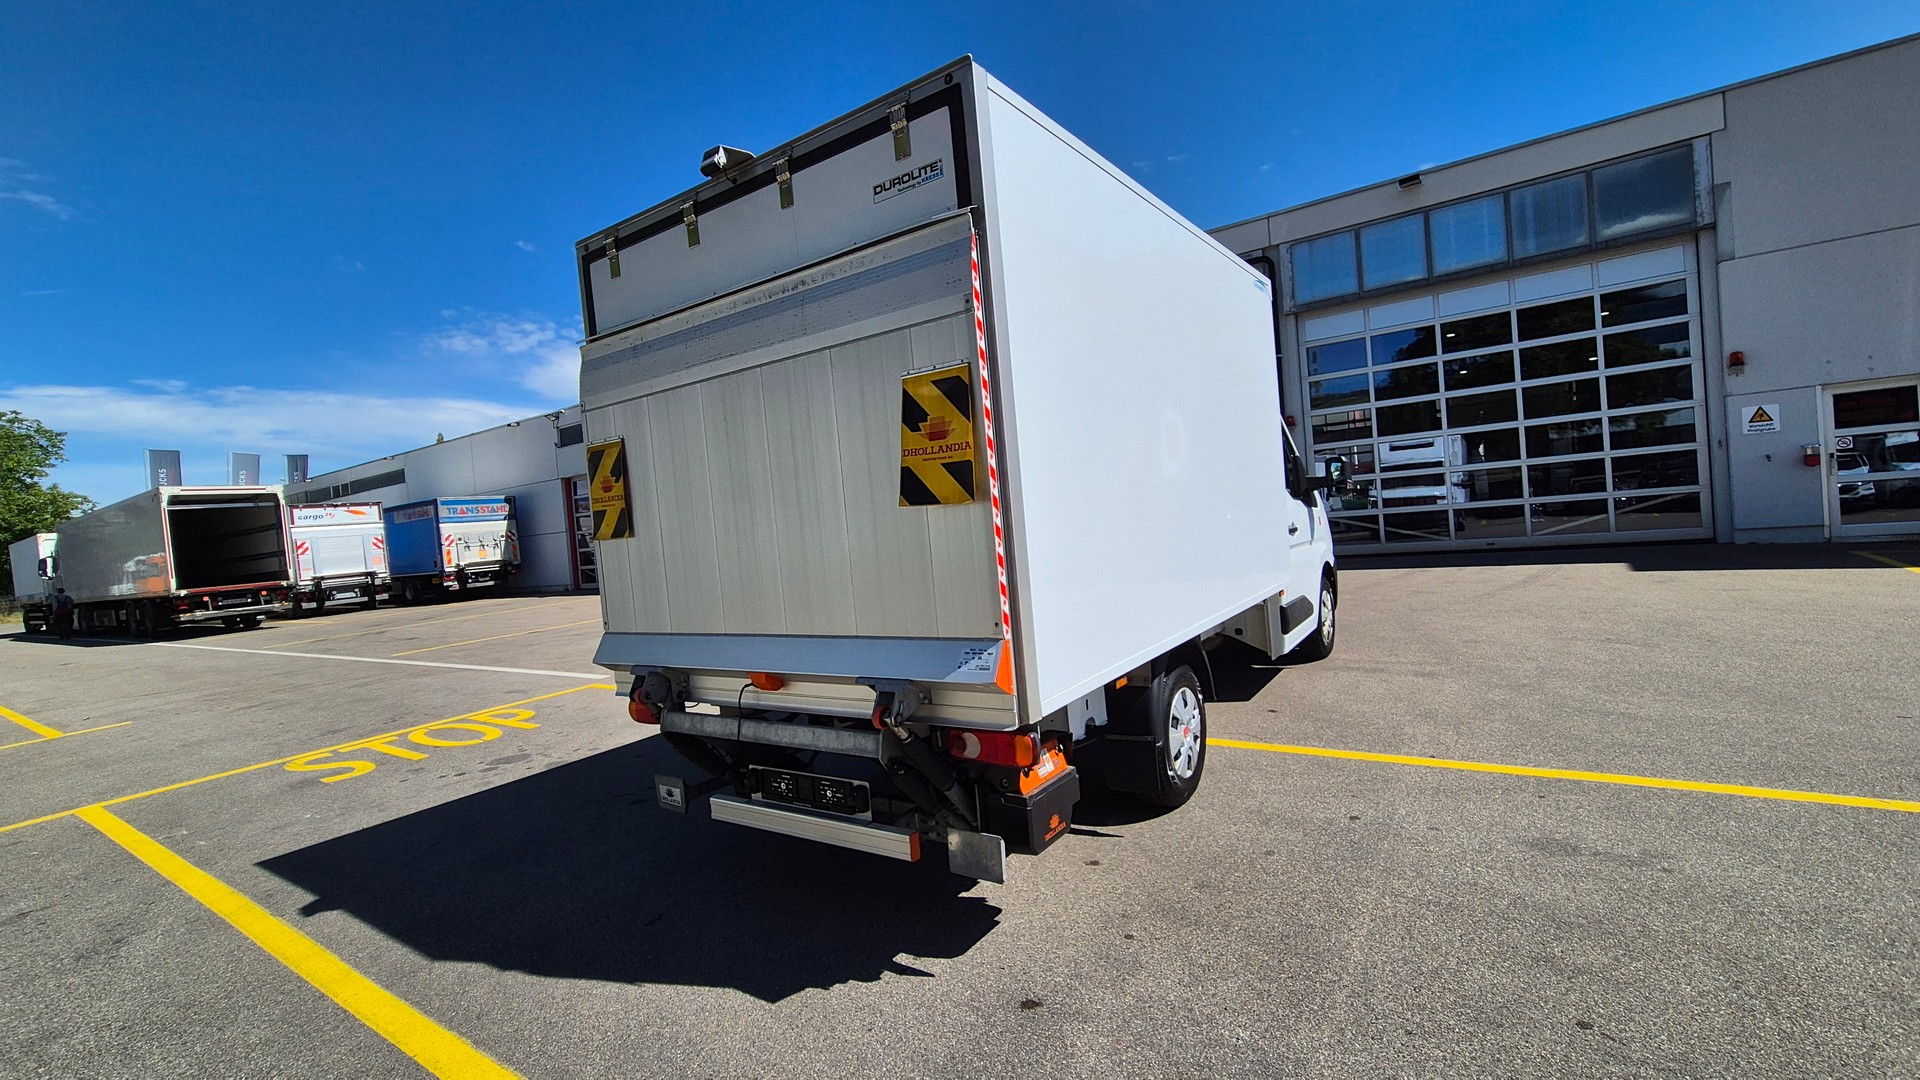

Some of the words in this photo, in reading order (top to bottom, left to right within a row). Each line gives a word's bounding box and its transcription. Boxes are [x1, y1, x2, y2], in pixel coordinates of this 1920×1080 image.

[873, 160, 940, 196] DUROLITE
[902, 441, 972, 458] DHOLLANDIA
[283, 709, 542, 783] STOP
